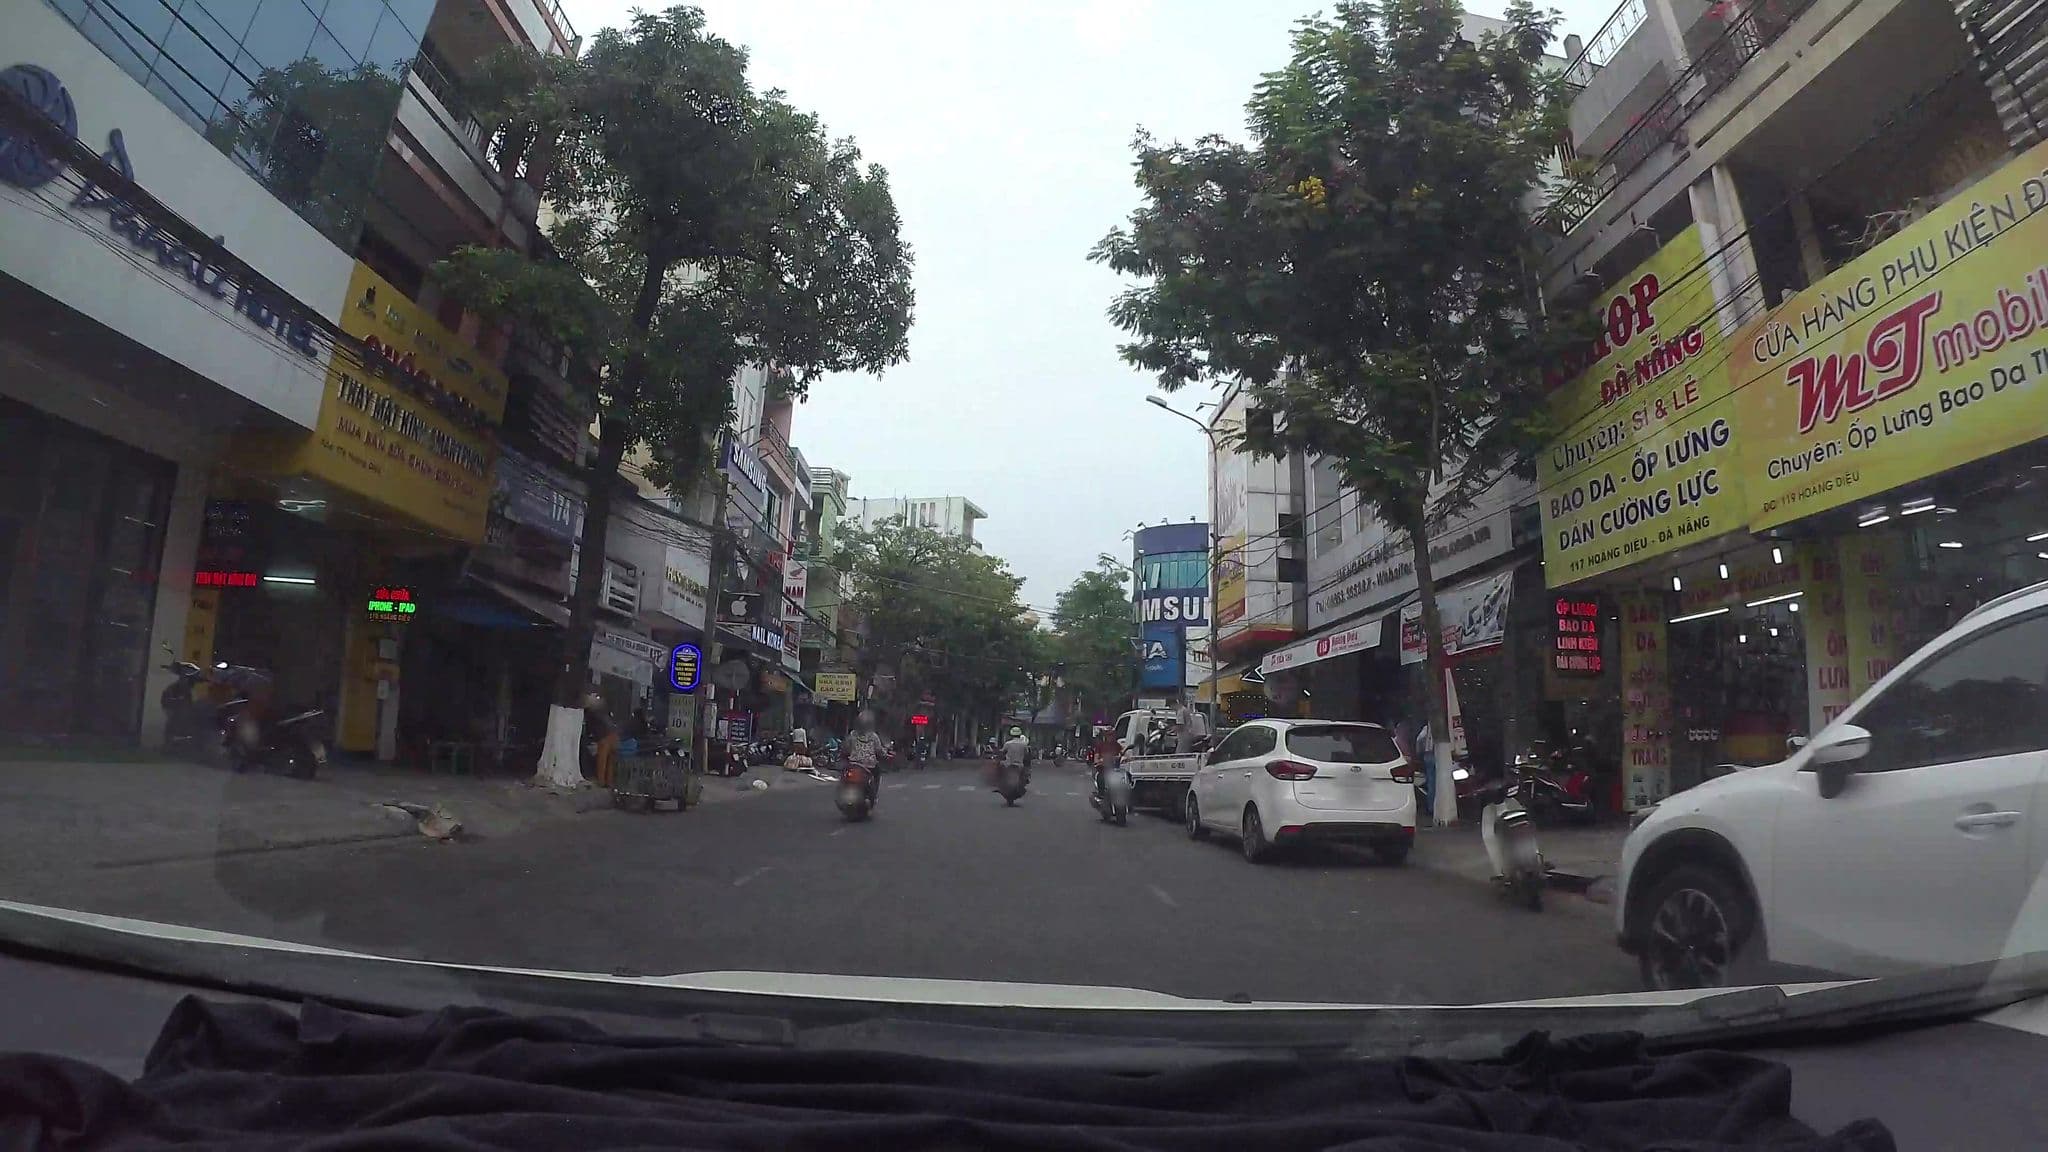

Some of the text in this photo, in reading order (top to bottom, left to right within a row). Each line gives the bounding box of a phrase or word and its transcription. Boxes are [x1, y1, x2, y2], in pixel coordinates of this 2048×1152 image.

[1754, 321, 1799, 362] CỬA
[1801, 277, 1876, 338] HÀNG
[1944, 194, 2016, 258] KIỆN
[1655, 399, 1668, 419] &
[1768, 438, 1843, 480] Chuyên:
[1848, 417, 1877, 449] Ốp
[1884, 403, 1933, 436] Lưng
[1939, 381, 1984, 414] Bao
[1991, 364, 2026, 393] Da
[733, 443, 767, 493] SAMSUNG
[1551, 487, 1584, 519] BAO
[1589, 473, 1616, 502] DA
[1631, 447, 1658, 482] ỐP
[1665, 418, 1730, 468] LƯNG
[1559, 469, 1719, 551] DÁN CƯỜNG LỰC
[1570, 558, 1584, 572] 117
[368, 600, 393, 612] IPHONE
[398, 602, 416, 613] IPAD
[752, 625, 766, 645] NAIL
[1559, 618, 1595, 633] BAO DA
